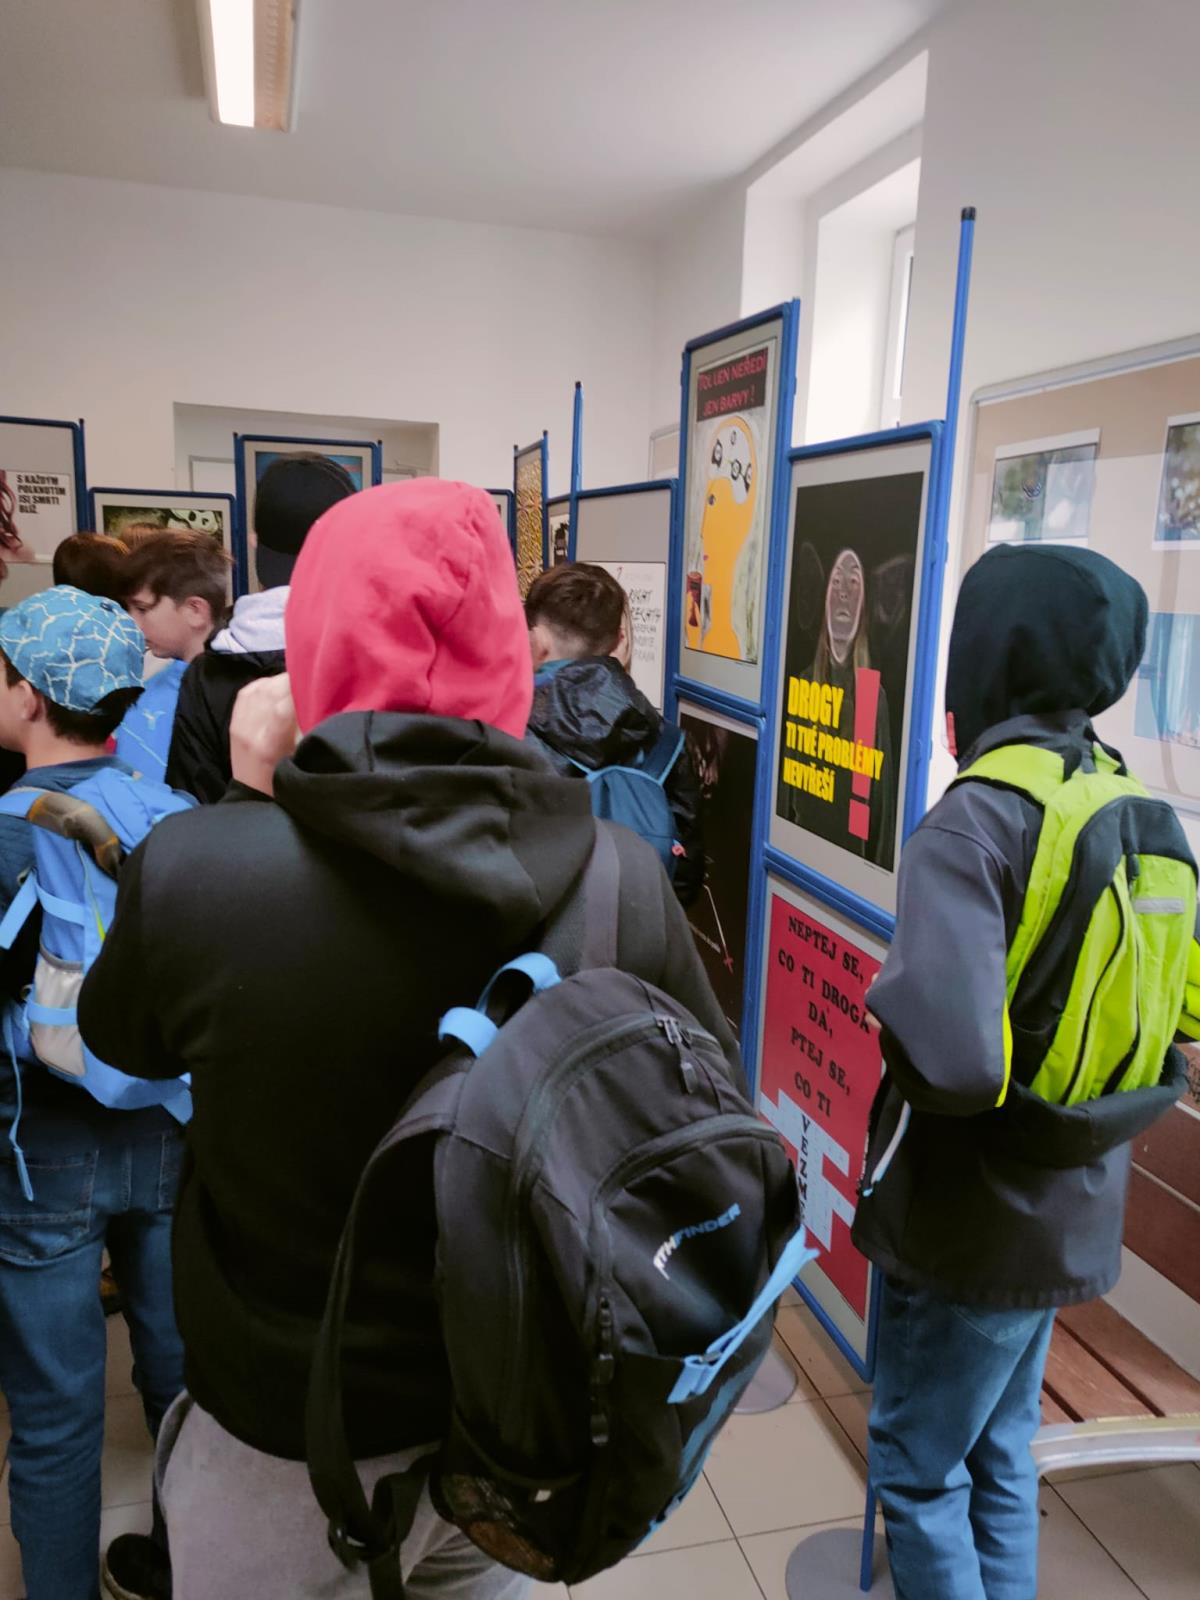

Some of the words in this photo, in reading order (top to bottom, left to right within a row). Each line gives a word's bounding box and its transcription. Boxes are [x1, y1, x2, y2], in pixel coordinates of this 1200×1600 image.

[17, 474, 23, 483] S
[787, 676, 844, 729] DROGY
[785, 721, 798, 750] TI
[797, 725, 818, 757] TVÉ
[817, 731, 884, 781] PROBLÉMY
[783, 756, 836, 803] NEVYŘEŠÍ
[788, 915, 837, 960] NEPTEJ
[842, 950, 864, 984] SE,
[778, 947, 795, 973] CO
[801, 965, 815, 989] TI
[821, 978, 870, 1034] DROGA
[791, 1026, 823, 1068] PTEJ
[828, 1060, 851, 1097] SE,
[794, 1071, 811, 1099] CO
[817, 1090, 831, 1118] TI
